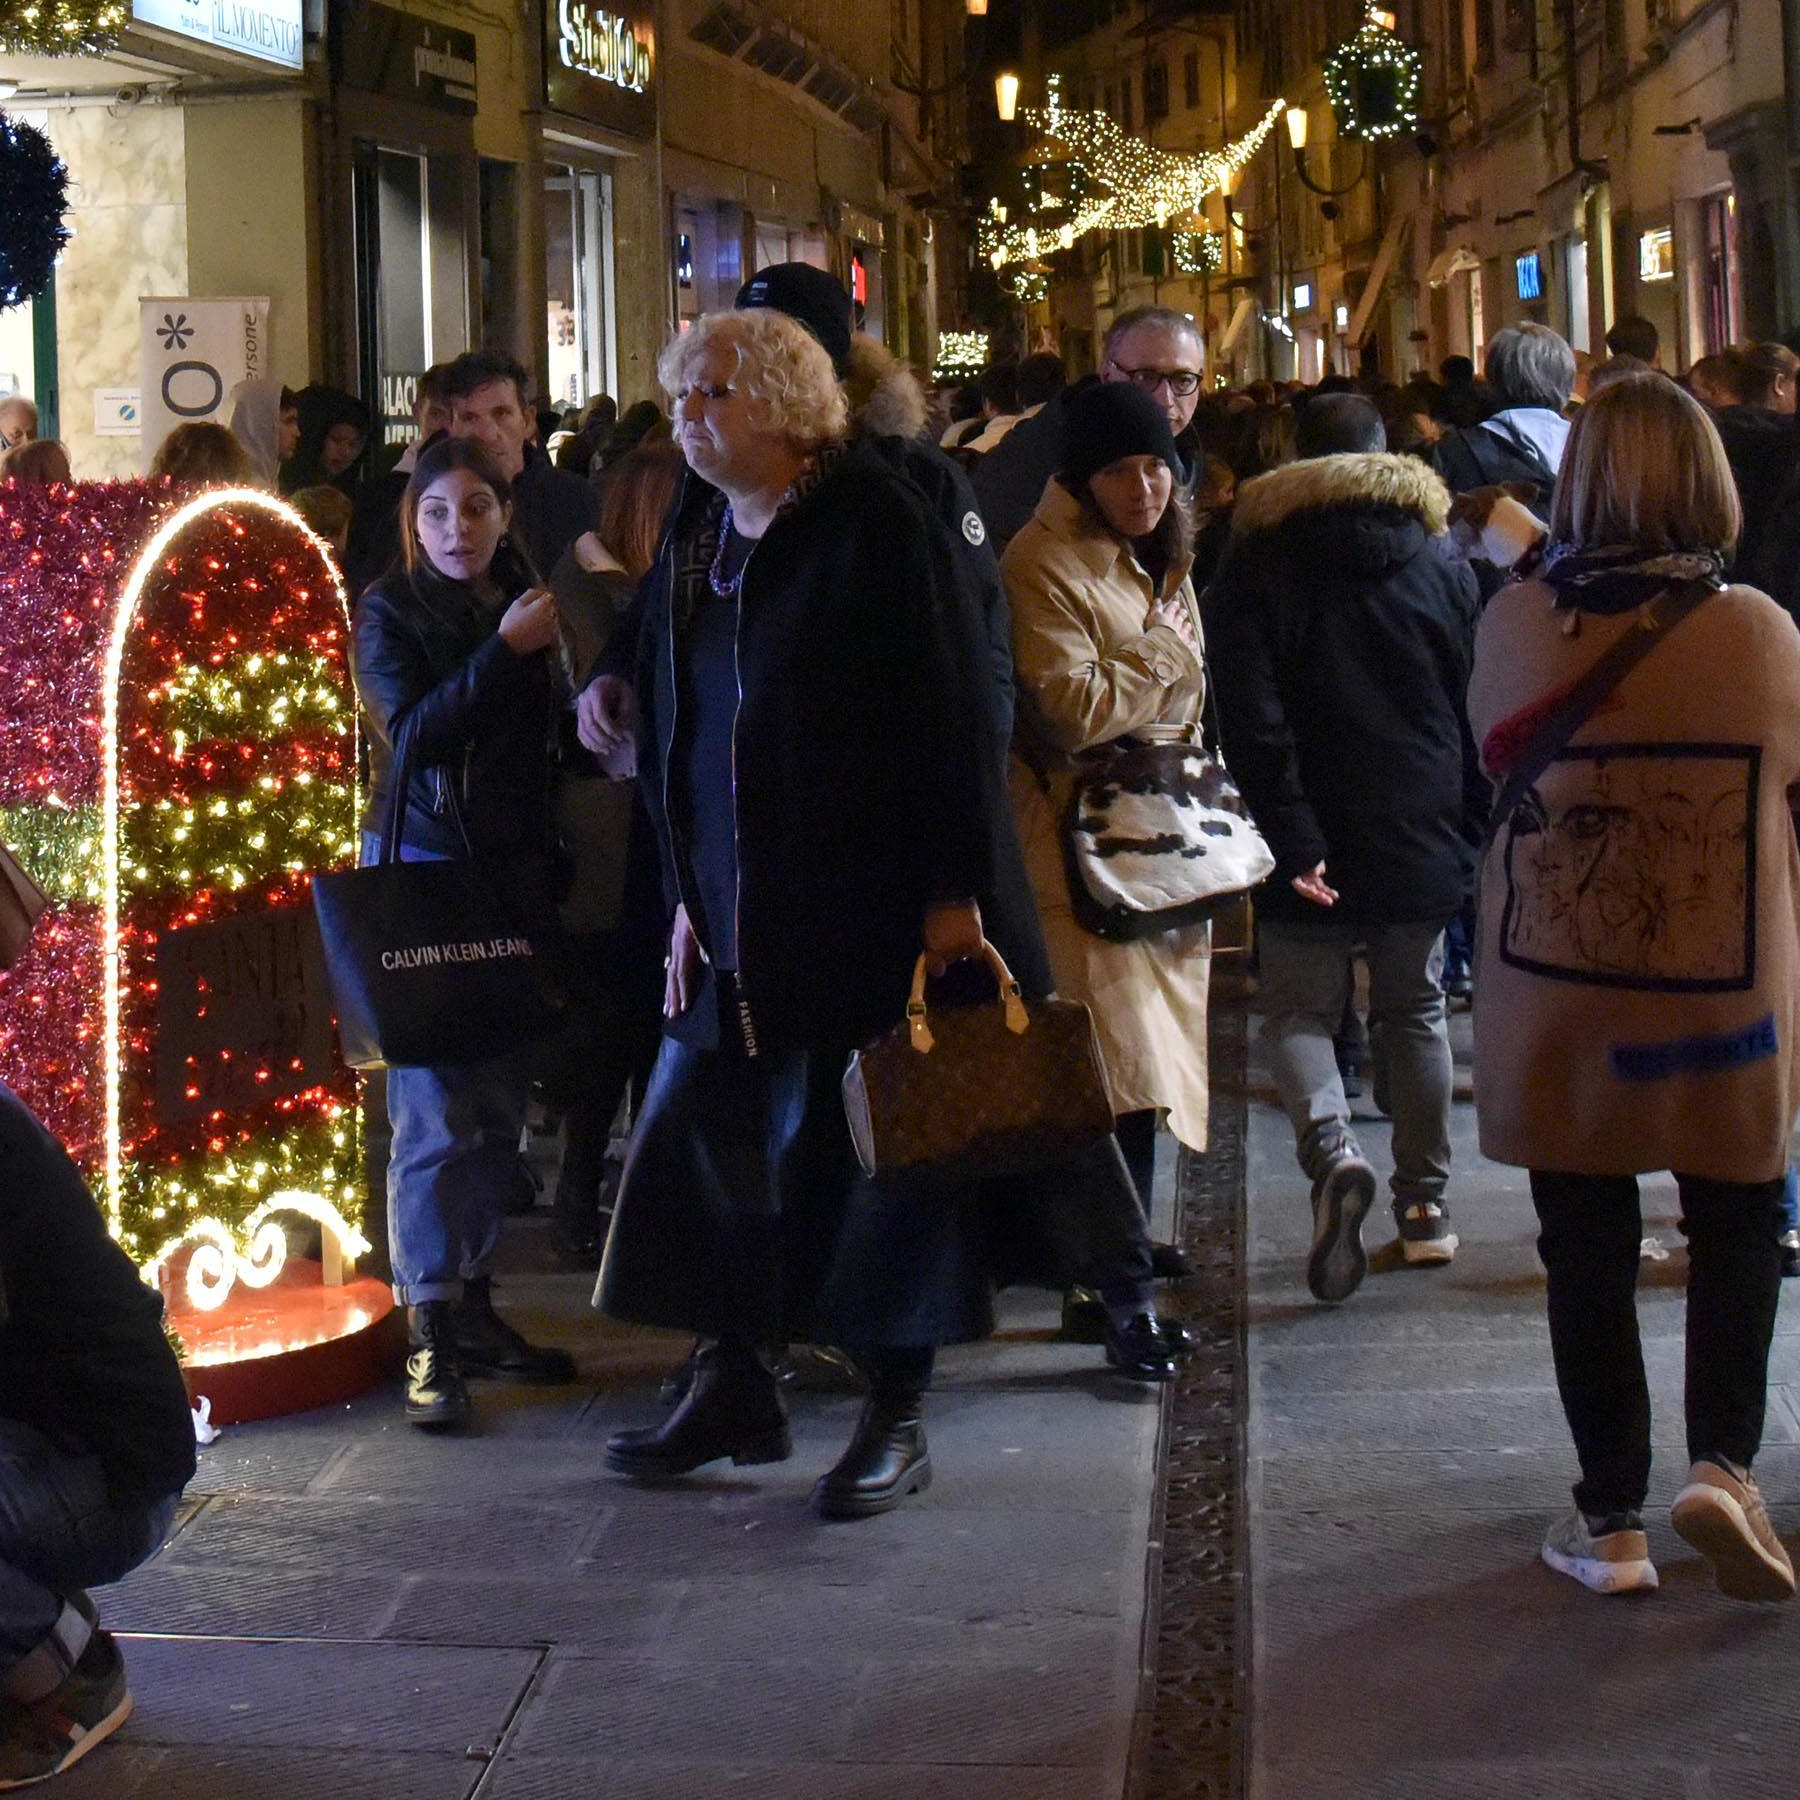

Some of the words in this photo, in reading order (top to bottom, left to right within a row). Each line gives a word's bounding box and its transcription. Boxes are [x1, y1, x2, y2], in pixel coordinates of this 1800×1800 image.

[244, 312, 258, 382] ersone
[381, 944, 441, 971] CALVIN
[443, 941, 487, 963] KLEIN
[737, 1000, 759, 1057] FASHION
